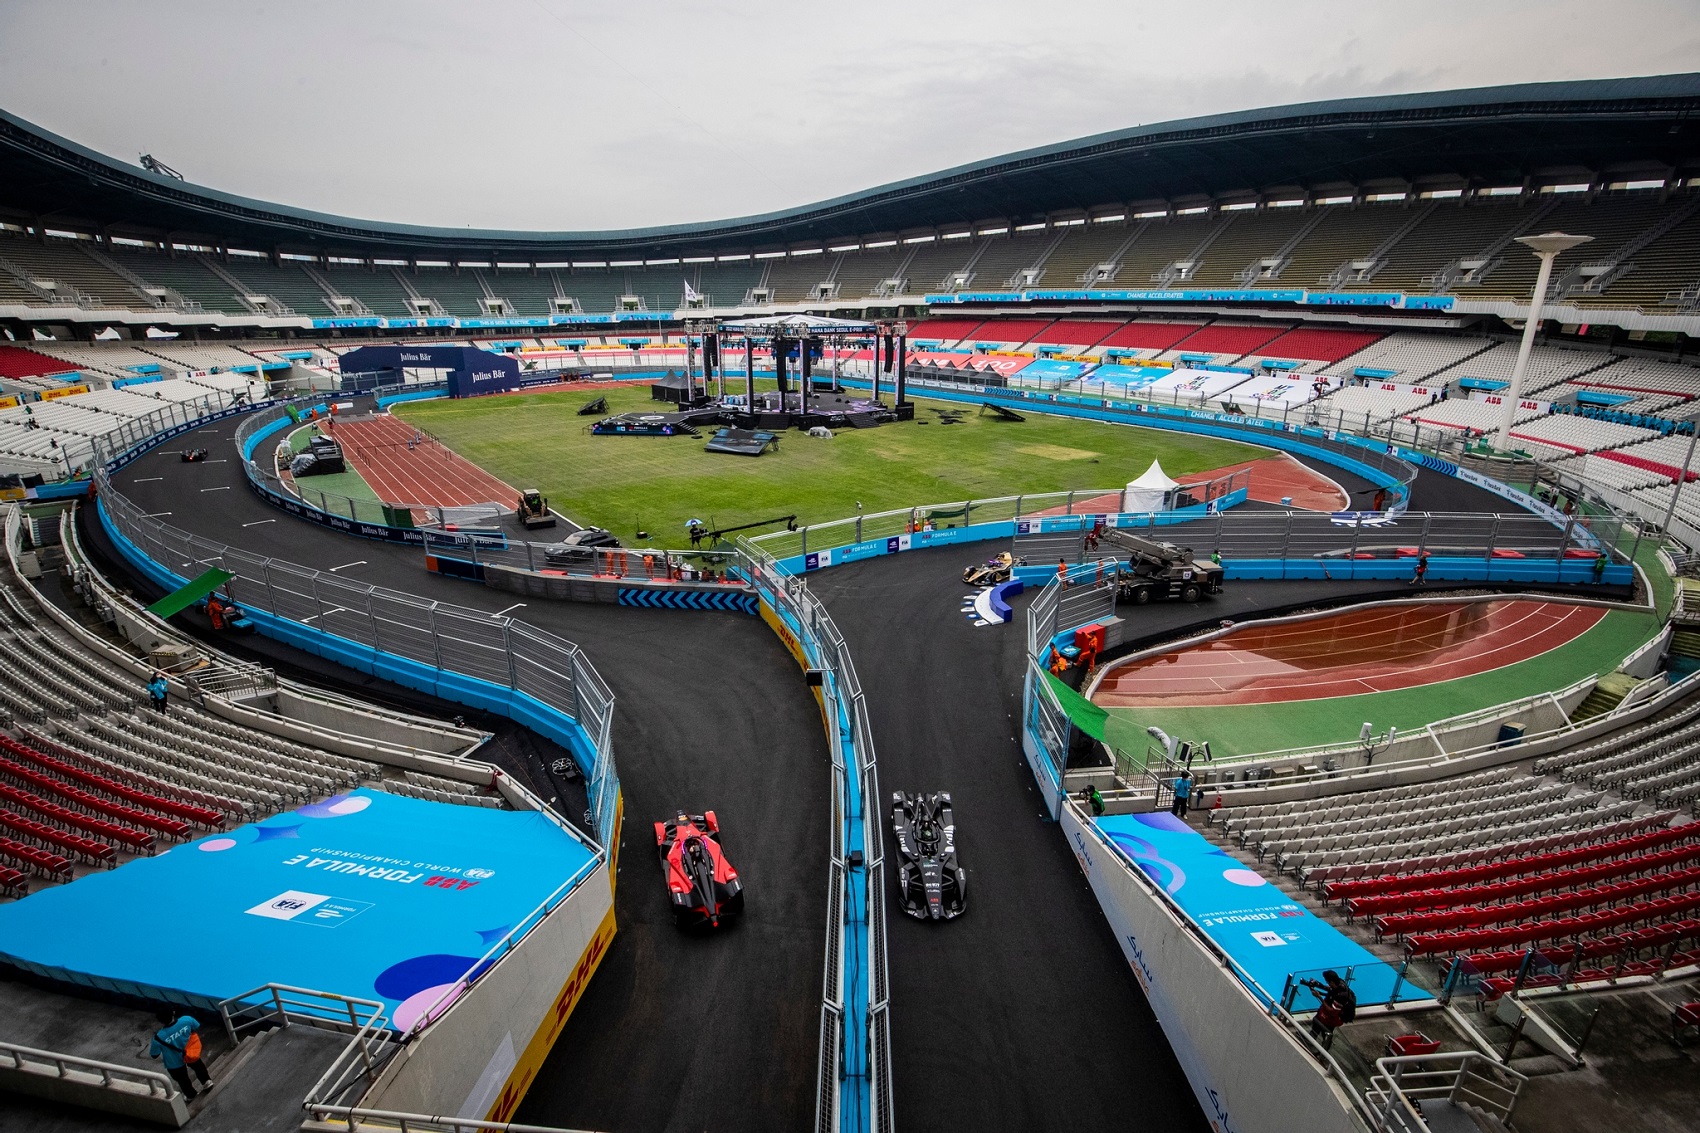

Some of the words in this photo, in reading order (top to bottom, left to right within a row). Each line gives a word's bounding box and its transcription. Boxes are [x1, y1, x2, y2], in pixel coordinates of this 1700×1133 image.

[400, 353, 419, 362] Julius
[419, 353, 431, 361] Bär
[472, 372, 492, 384] Julius
[492, 369, 506, 379] Bär
[1412, 387, 1428, 395] ABB
[1485, 396, 1502, 405] ABB
[1520, 401, 1538, 411] ABB
[361, 525, 378, 535] Julius
[378, 527, 389, 537] Bär
[403, 531, 423, 541] Julius
[852, 545, 873, 553] FORMULA
[282, 854, 304, 866] E
[310, 847, 411, 867] CHAMPIONSHIP
[305, 857, 424, 884] FORMULA
[413, 862, 462, 874] WORLD
[423, 875, 480, 891] ABB
[277, 899, 306, 911] FIA
[1198, 908, 1254, 918] CHAMPIONSHIP
[1213, 912, 1278, 925] FORMULA
[1203, 919, 1214, 927] E
[556, 933, 605, 1028] DHL
[164, 1025, 189, 1044] STAFF
